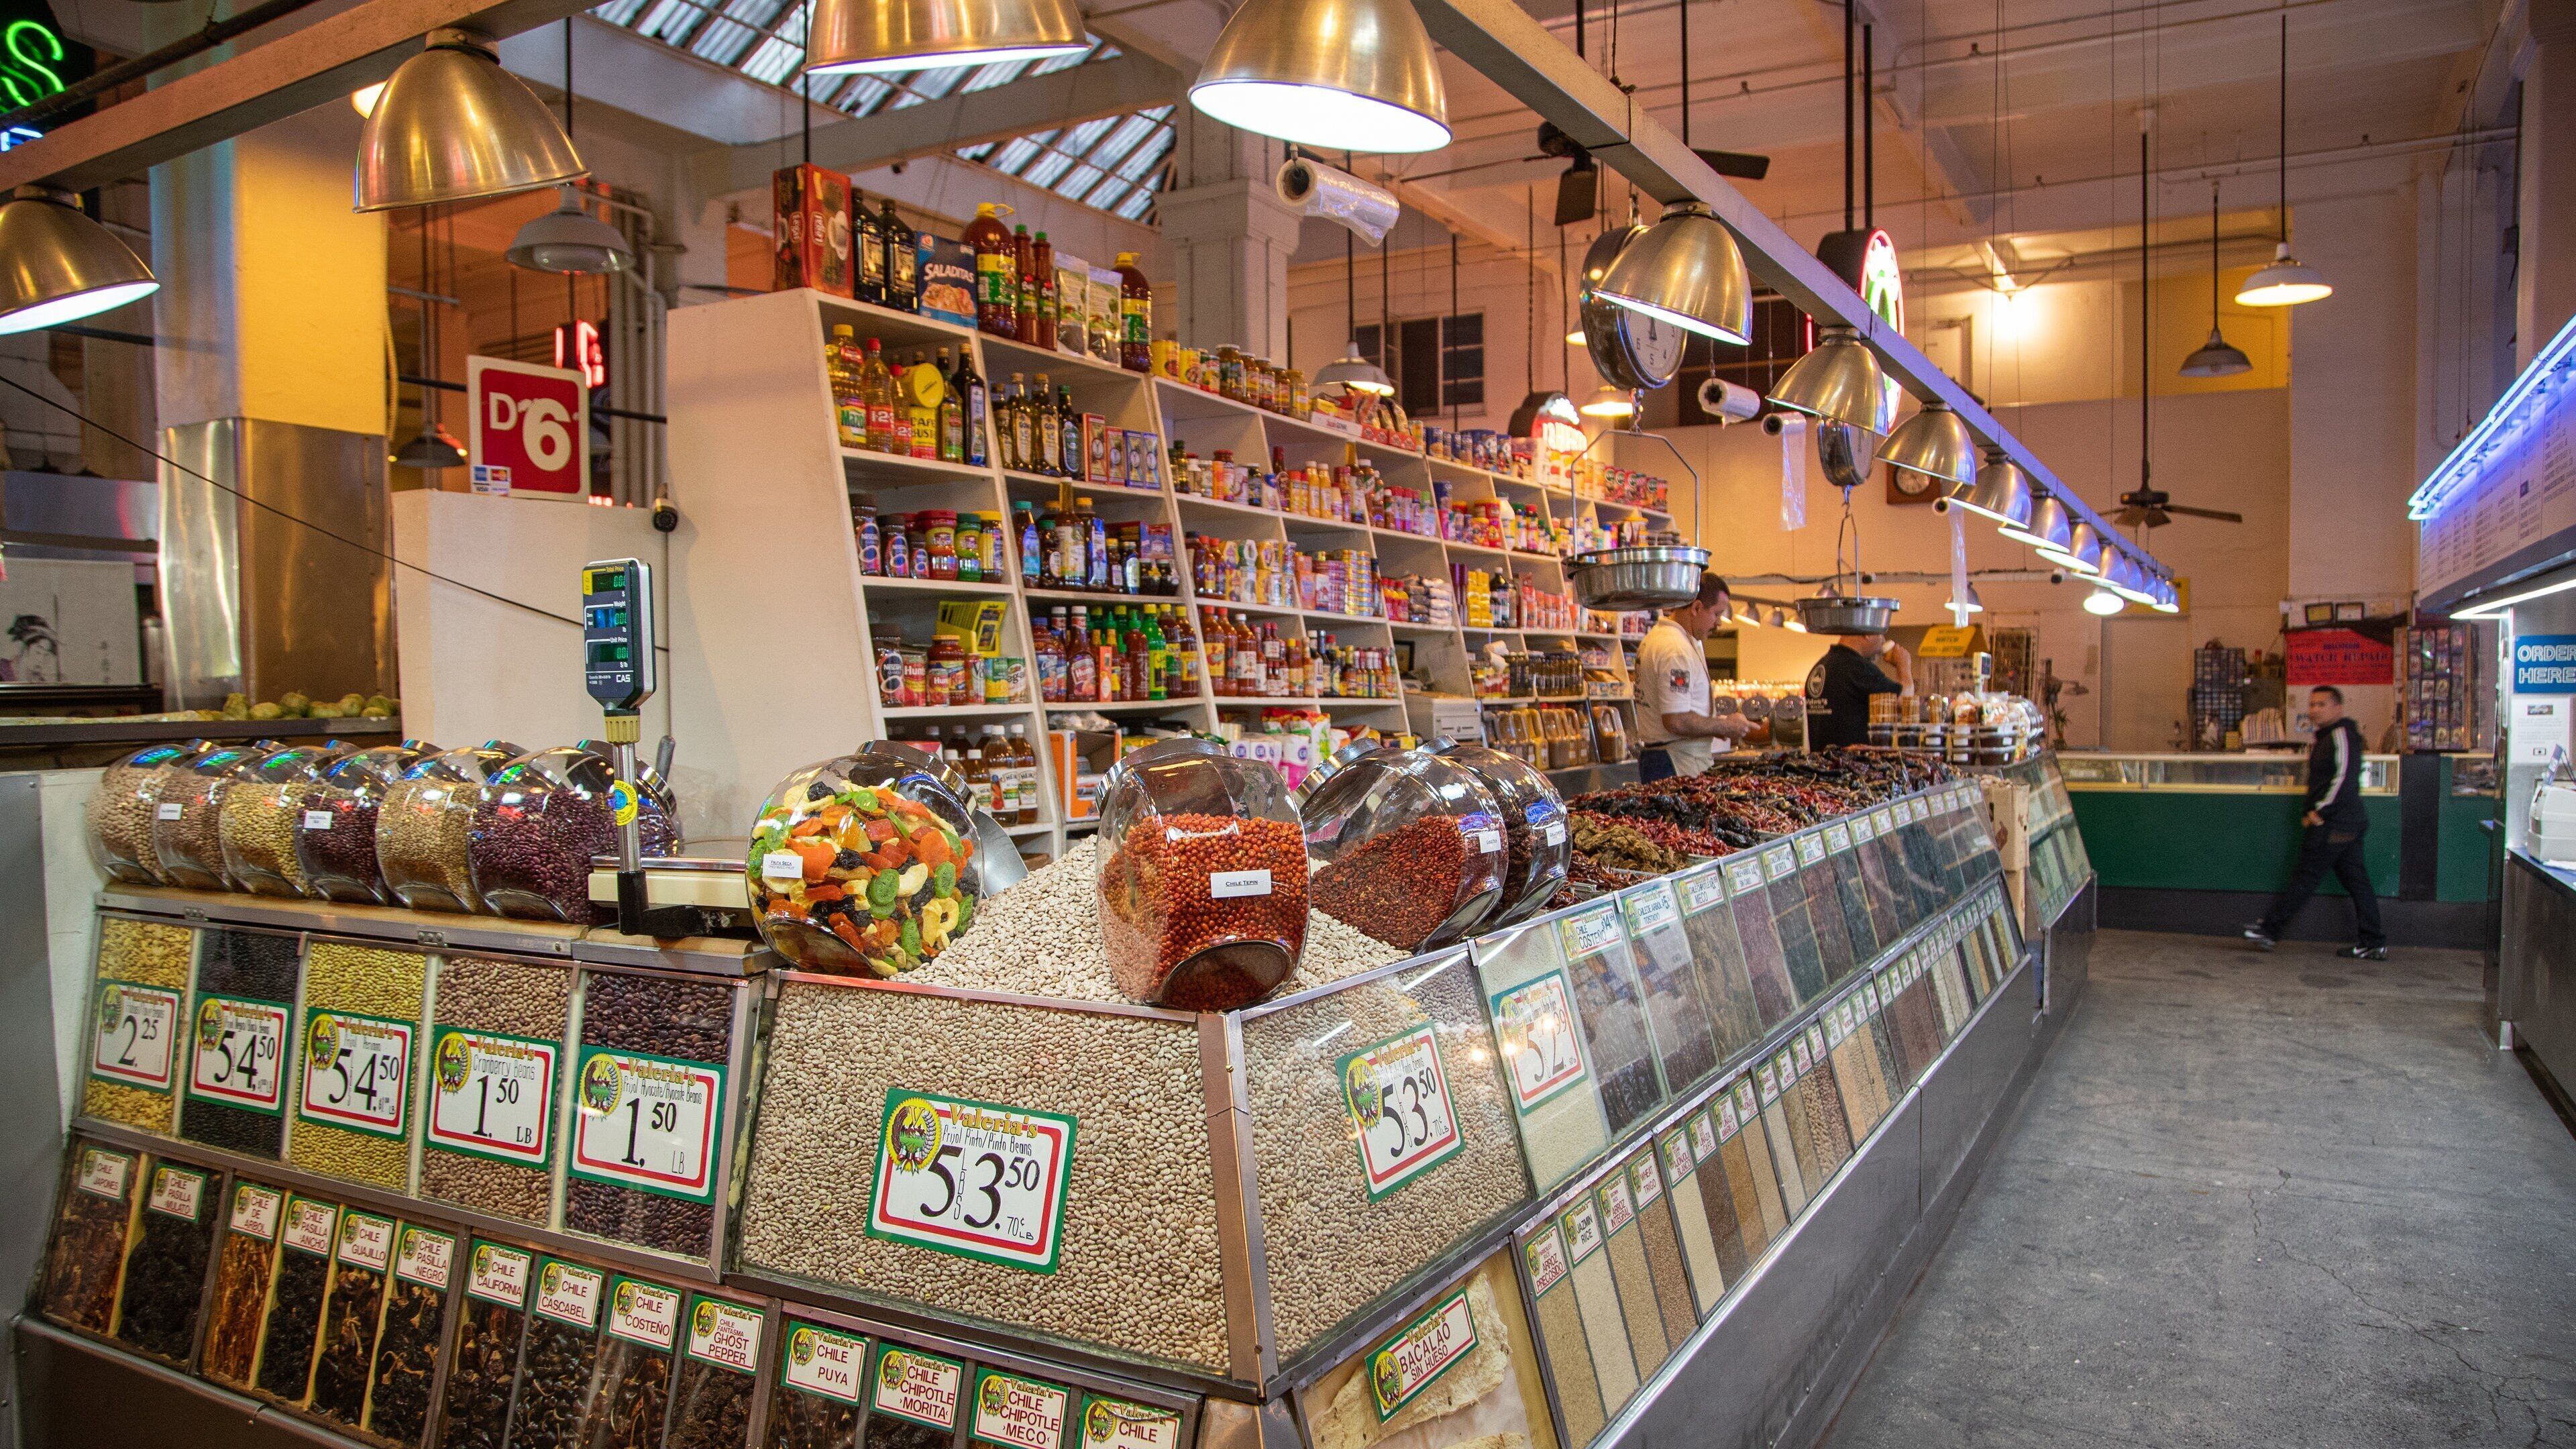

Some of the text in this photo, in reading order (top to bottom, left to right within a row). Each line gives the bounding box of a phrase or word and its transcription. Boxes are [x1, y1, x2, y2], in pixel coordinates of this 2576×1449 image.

[923, 263, 974, 283] SALADITAS
[2518, 645, 2576, 662] ORDER
[616, 674, 631, 682] CAS
[2518, 667, 2576, 684] HERE
[1695, 892, 1708, 904] MECO
[1576, 924, 1588, 935] CHILE
[343, 1016, 395, 1040] Valeria's
[214, 1030, 235, 1082] 5
[475, 1035, 535, 1061] Valeria's
[1373, 1033, 1421, 1068] Valeria's
[328, 1048, 353, 1104] 5
[473, 1055, 535, 1080] Cranberry Beans
[628, 1057, 696, 1086] Valeria's
[623, 1075, 638, 1093] Frijol
[686, 1085, 702, 1104] Beans
[949, 1104, 1038, 1138] Valeria's
[1382, 1083, 1404, 1157] 5
[517, 1126, 532, 1144] LB
[943, 1124, 962, 1145] Frijol
[1010, 1136, 1032, 1157] Beans
[97, 1163, 113, 1174] CHILE
[672, 1150, 684, 1174] LB
[920, 1144, 963, 1218] 5
[1640, 1165, 1653, 1181] WHEAT
[93, 1178, 119, 1191] JAPONES
[170, 1177, 187, 1189] CHILE
[1644, 1179, 1656, 1194] TRIGO
[168, 1188, 192, 1203] PASILLA
[252, 1196, 269, 1209] CHILE
[252, 1209, 261, 1219] DE
[305, 1210, 324, 1224] CHILE
[1612, 1199, 1625, 1216] ARROZ
[244, 1219, 266, 1234] ARBOL
[1576, 1214, 1593, 1234] JAZMIN
[1611, 1208, 1630, 1228] INTEGRAL
[302, 1222, 327, 1236] PASILLA
[360, 1228, 380, 1242] CHILE
[1580, 1228, 1593, 1244] RICE
[352, 1244, 386, 1261] GUAJILLO
[419, 1240, 441, 1255] CHILE
[417, 1252, 447, 1269] PASILLA
[492, 1261, 516, 1277] CHILE
[1542, 1253, 1558, 1273] ARROZ
[564, 1265, 594, 1281] Valeria's
[1536, 1261, 1564, 1291] PRECOSIDO
[477, 1276, 522, 1297] CALIFORNIA
[561, 1281, 588, 1297] CHILE
[637, 1283, 669, 1301] Valeria's
[541, 1296, 586, 1319] CASCABEL
[636, 1296, 663, 1313] CHILE
[718, 1303, 753, 1322] Valeria's
[625, 1314, 669, 1336] COSTEÑO
[717, 1326, 744, 1337] FANTASMA
[720, 1318, 735, 1328] CHILE
[1405, 1309, 1446, 1346] Valeria's
[714, 1332, 749, 1350] GHOST
[816, 1330, 855, 1349] Valeria's
[1399, 1322, 1450, 1375] BACALAO
[708, 1344, 747, 1364] PEPPER
[817, 1344, 849, 1363] CHILE
[1411, 1344, 1448, 1381] SIN HUESO
[908, 1354, 949, 1373] Valeria's
[818, 1366, 848, 1386] PUYA
[907, 1366, 939, 1385] CHILE
[900, 1380, 955, 1405] CHIPOTLE
[1010, 1379, 1055, 1398] Valeria's
[1008, 1391, 1044, 1411] CHILE
[1000, 1405, 1059, 1432] CHIPOTLE
[1118, 1421, 1158, 1442] CHILE
